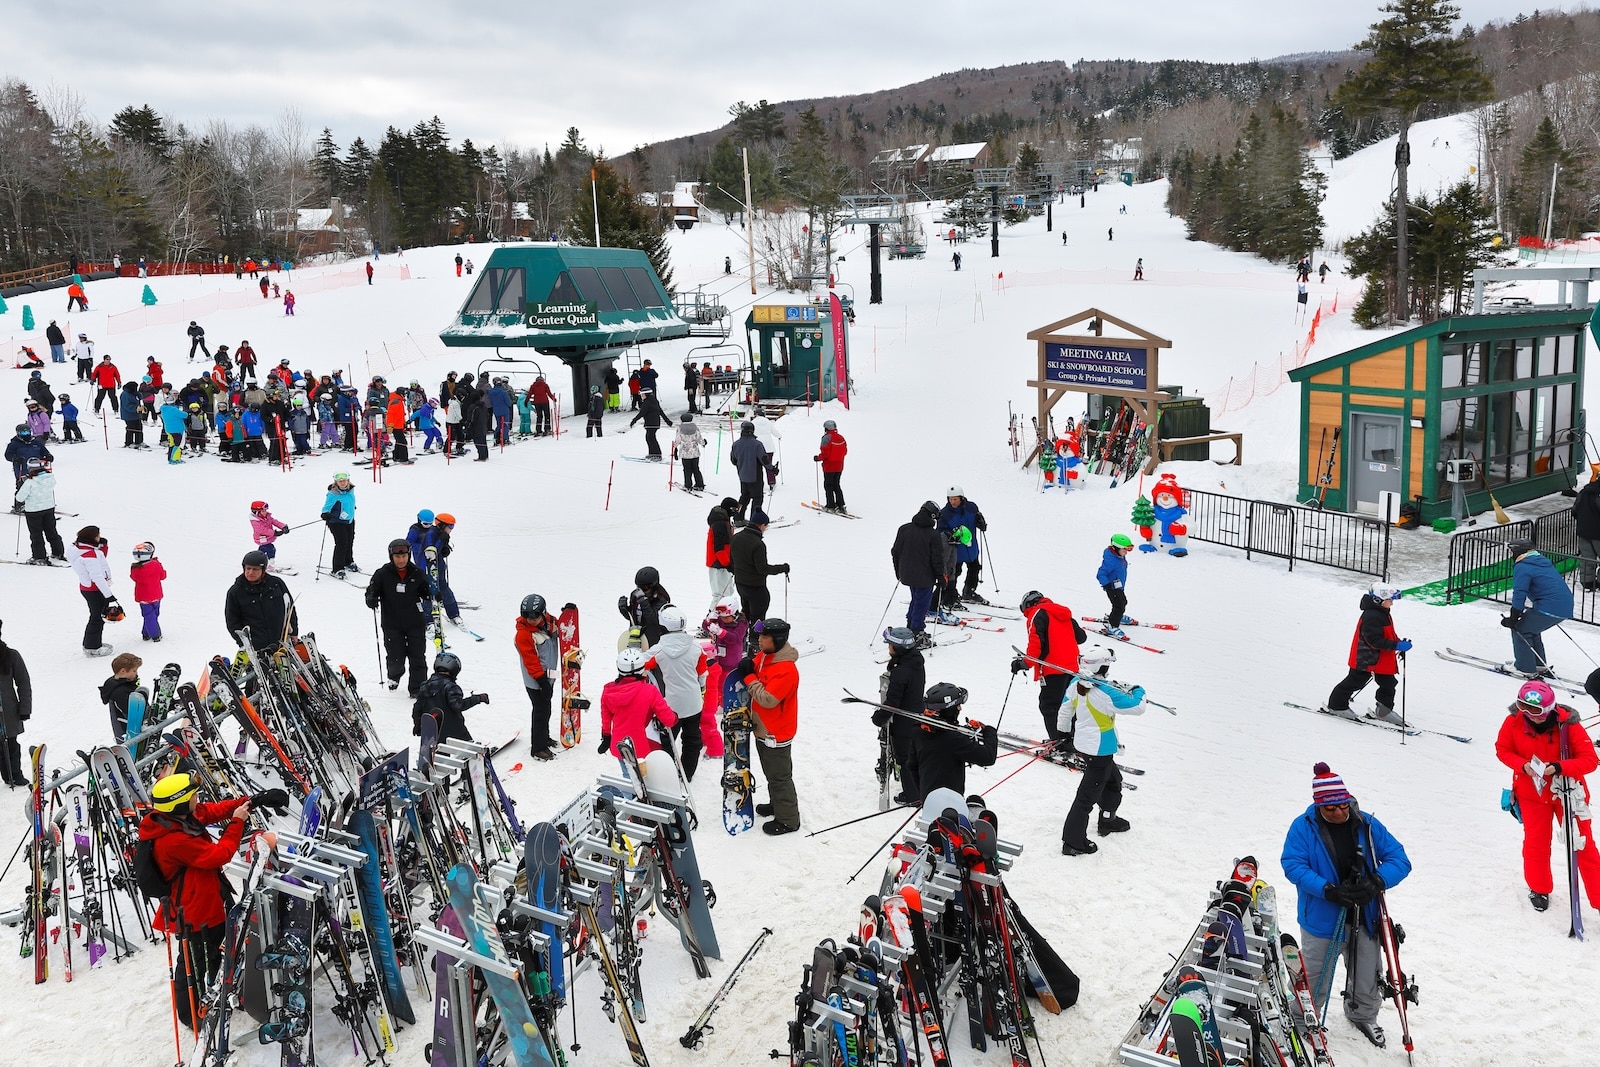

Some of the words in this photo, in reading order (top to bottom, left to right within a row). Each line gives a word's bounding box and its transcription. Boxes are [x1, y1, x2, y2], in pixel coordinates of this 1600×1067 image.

[537, 302, 587, 315] Learning
[528, 315, 565, 325] Center
[567, 313, 596, 326] Quad
[1060, 348, 1103, 360] MEETING
[1105, 351, 1132, 362] AREA
[1047, 361, 1059, 369] SKI
[1067, 363, 1113, 373] SNOWBOARD
[1114, 367, 1146, 376] SCHOOL
[1058, 372, 1078, 381] Group
[1085, 374, 1107, 383] Private
[1108, 376, 1134, 386] Lessons
[188, 701, 204, 734] HEAD
[981, 884, 989, 906] HEA
